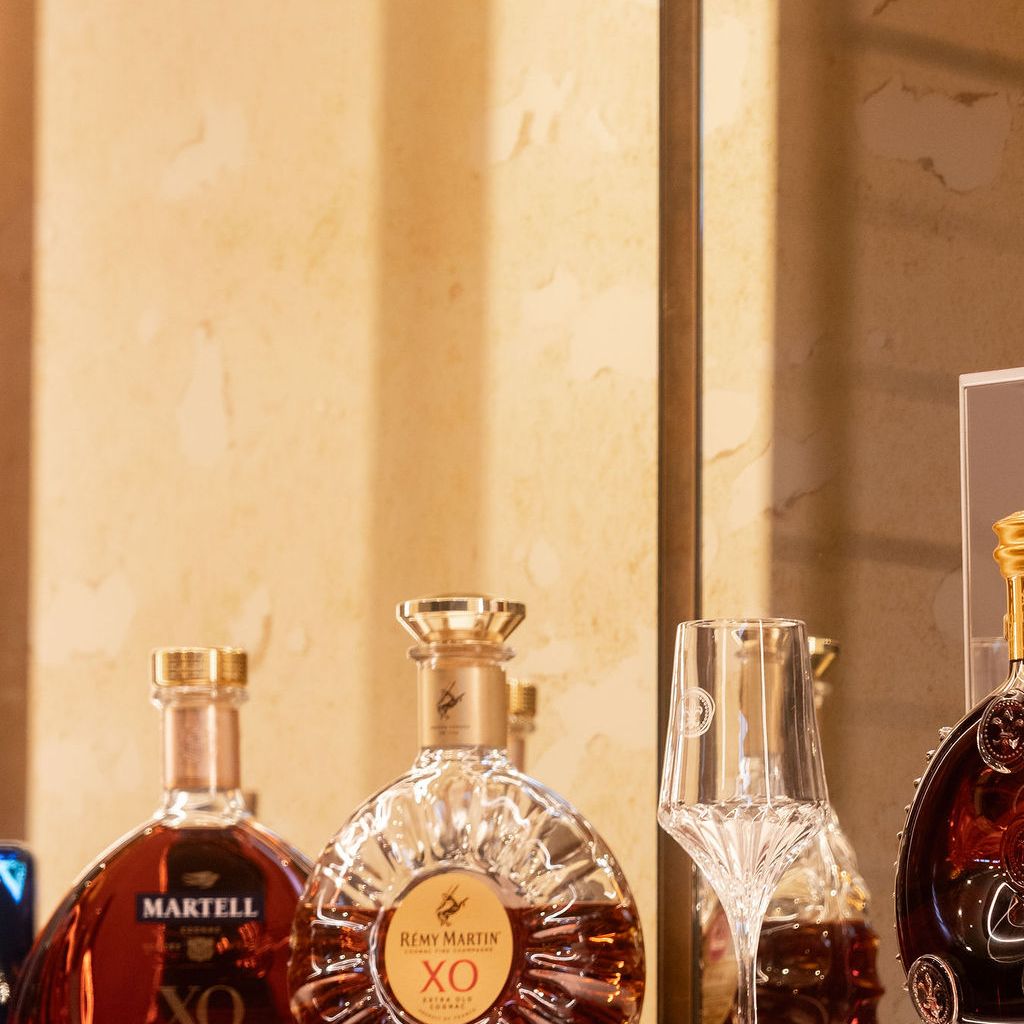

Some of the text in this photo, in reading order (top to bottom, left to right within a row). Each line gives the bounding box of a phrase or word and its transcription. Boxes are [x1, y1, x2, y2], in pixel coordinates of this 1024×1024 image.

[143, 897, 258, 918] MARTELL
[400, 929, 498, 947] RÉMY MARTIN
[420, 959, 478, 993] XO
